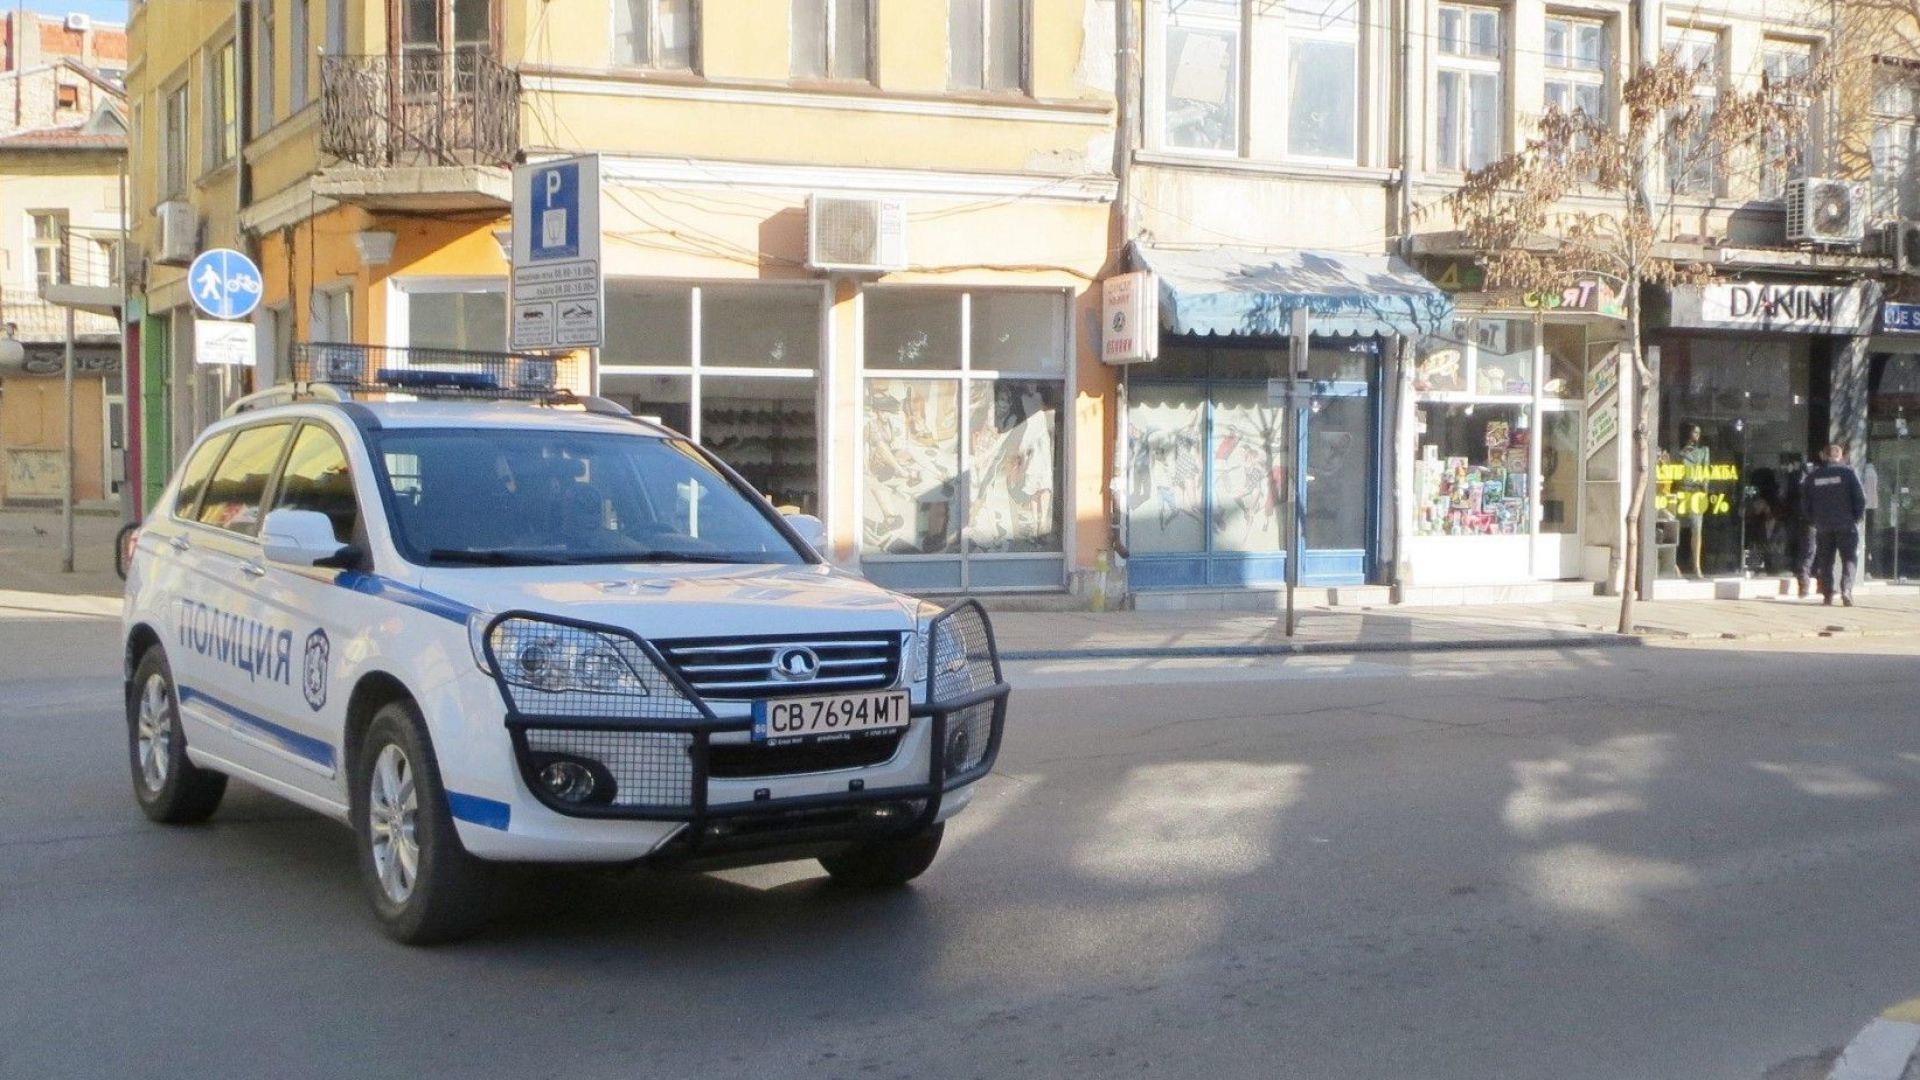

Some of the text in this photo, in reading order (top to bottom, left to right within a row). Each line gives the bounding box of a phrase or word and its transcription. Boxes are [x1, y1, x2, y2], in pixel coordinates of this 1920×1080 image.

[546, 169, 562, 208] P
[1731, 286, 1834, 322] DAKINI
[1656, 464, 1738, 480] АЗПРОДАЖБА
[180, 598, 293, 685] ПОЛИЦИЯ
[810, 698, 869, 730] 7694
